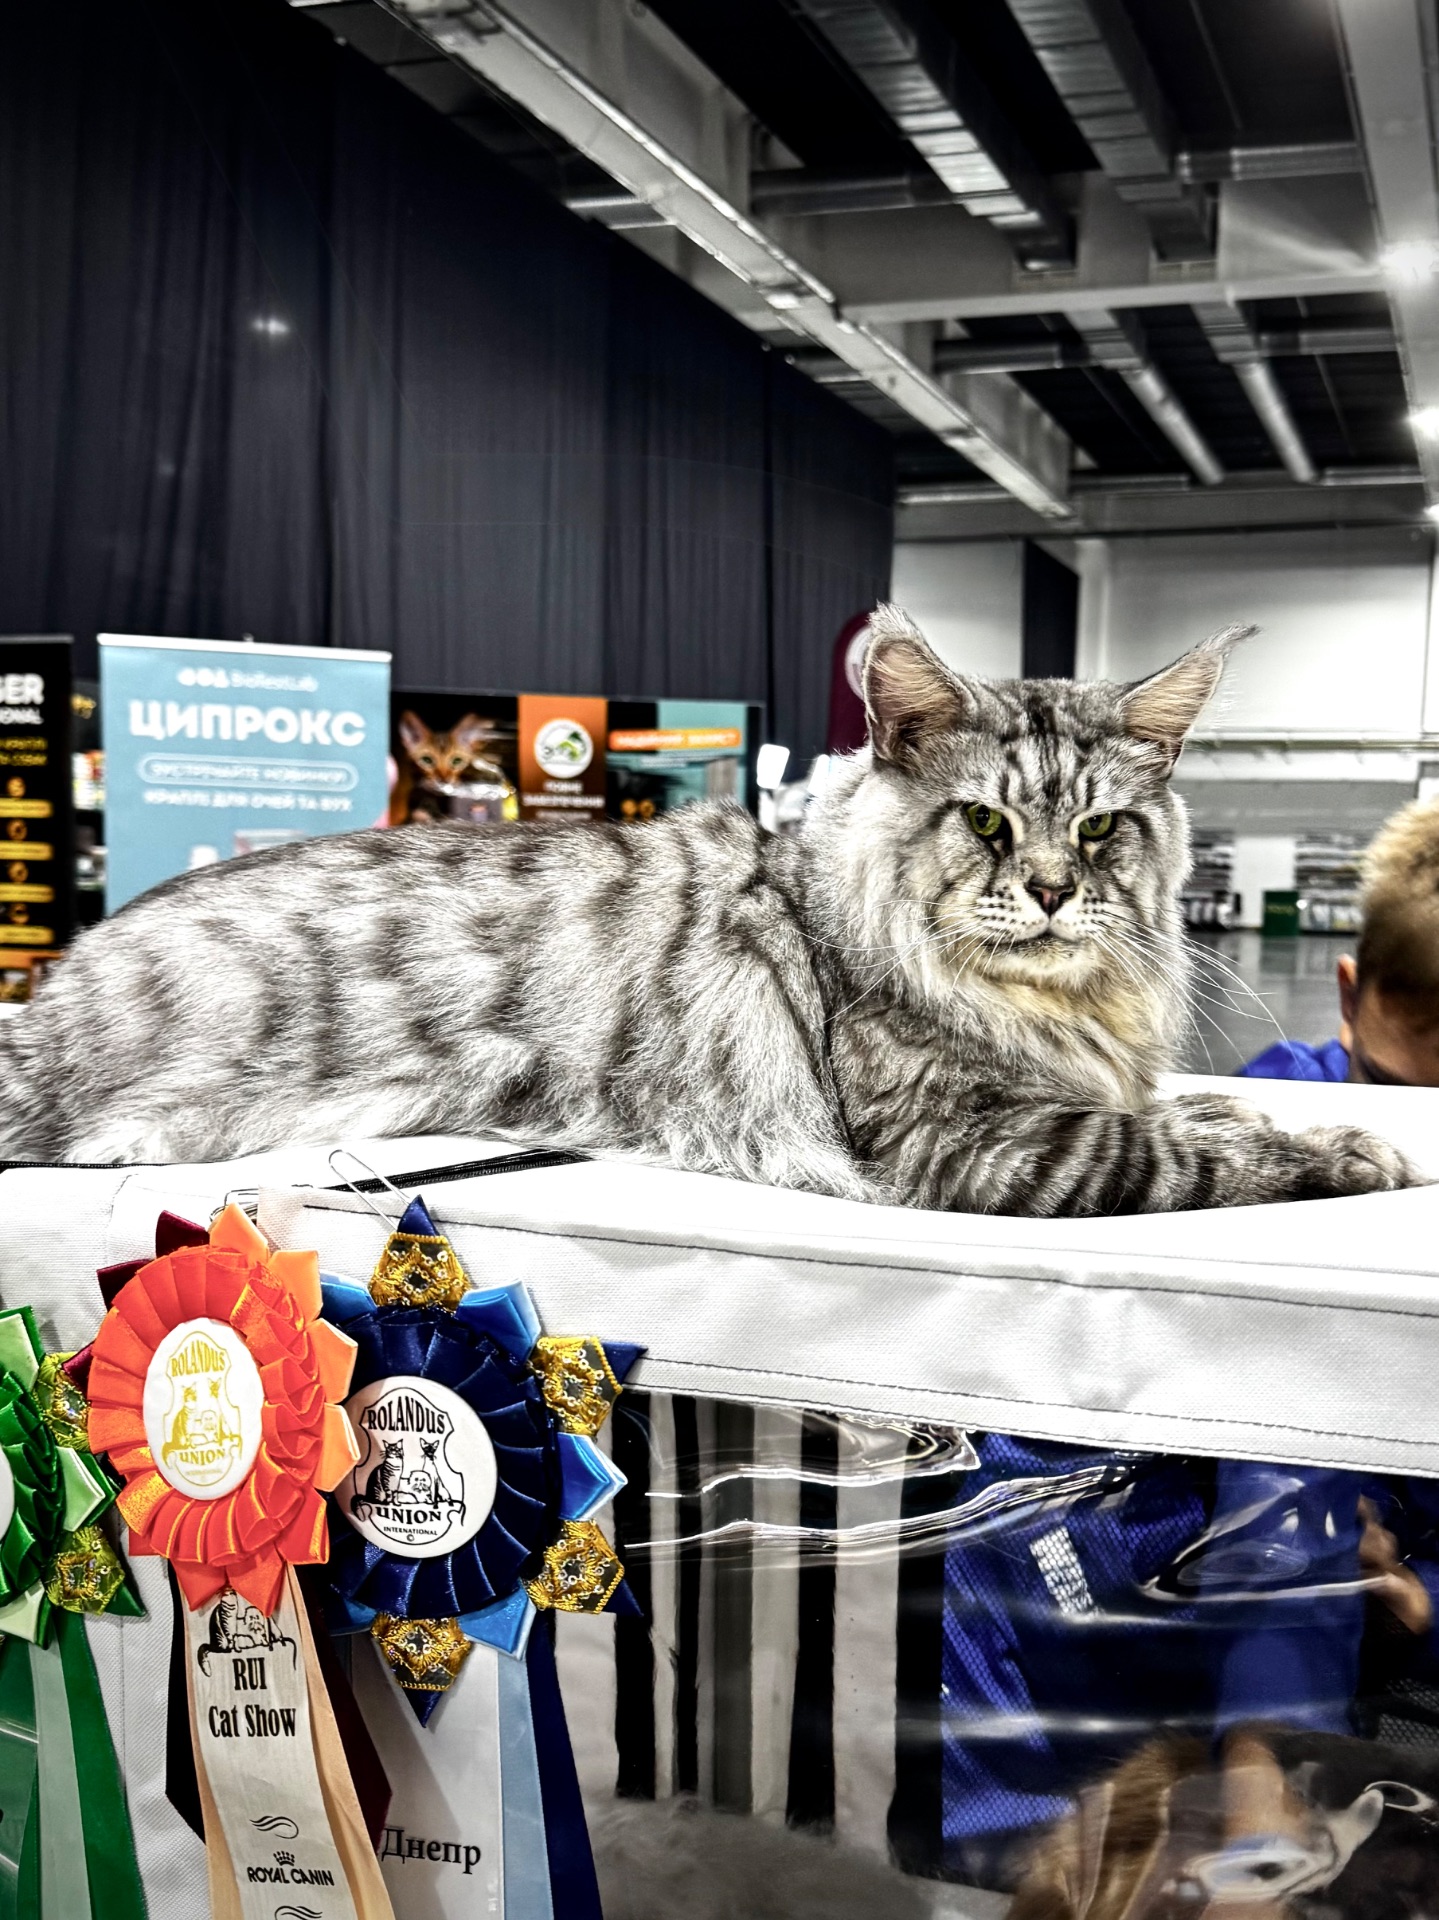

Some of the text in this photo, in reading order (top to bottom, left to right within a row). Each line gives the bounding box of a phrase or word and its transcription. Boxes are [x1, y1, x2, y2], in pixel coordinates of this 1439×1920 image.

[0, 673, 44, 705] ER
[129, 699, 366, 746] ЦИПРОКС
[171, 1339, 225, 1377] ROLANDUS
[367, 1395, 445, 1434] ROLANDUS
[179, 1448, 225, 1466] UNION
[375, 1506, 441, 1524] UNION
[383, 1526, 438, 1536] INTERNATIONAL
[232, 1657, 267, 1690] RUI
[208, 1704, 296, 1737] Cat Show
[381, 1826, 481, 1875] Днепр
[247, 1866, 335, 1886] ROYAL CANIN
